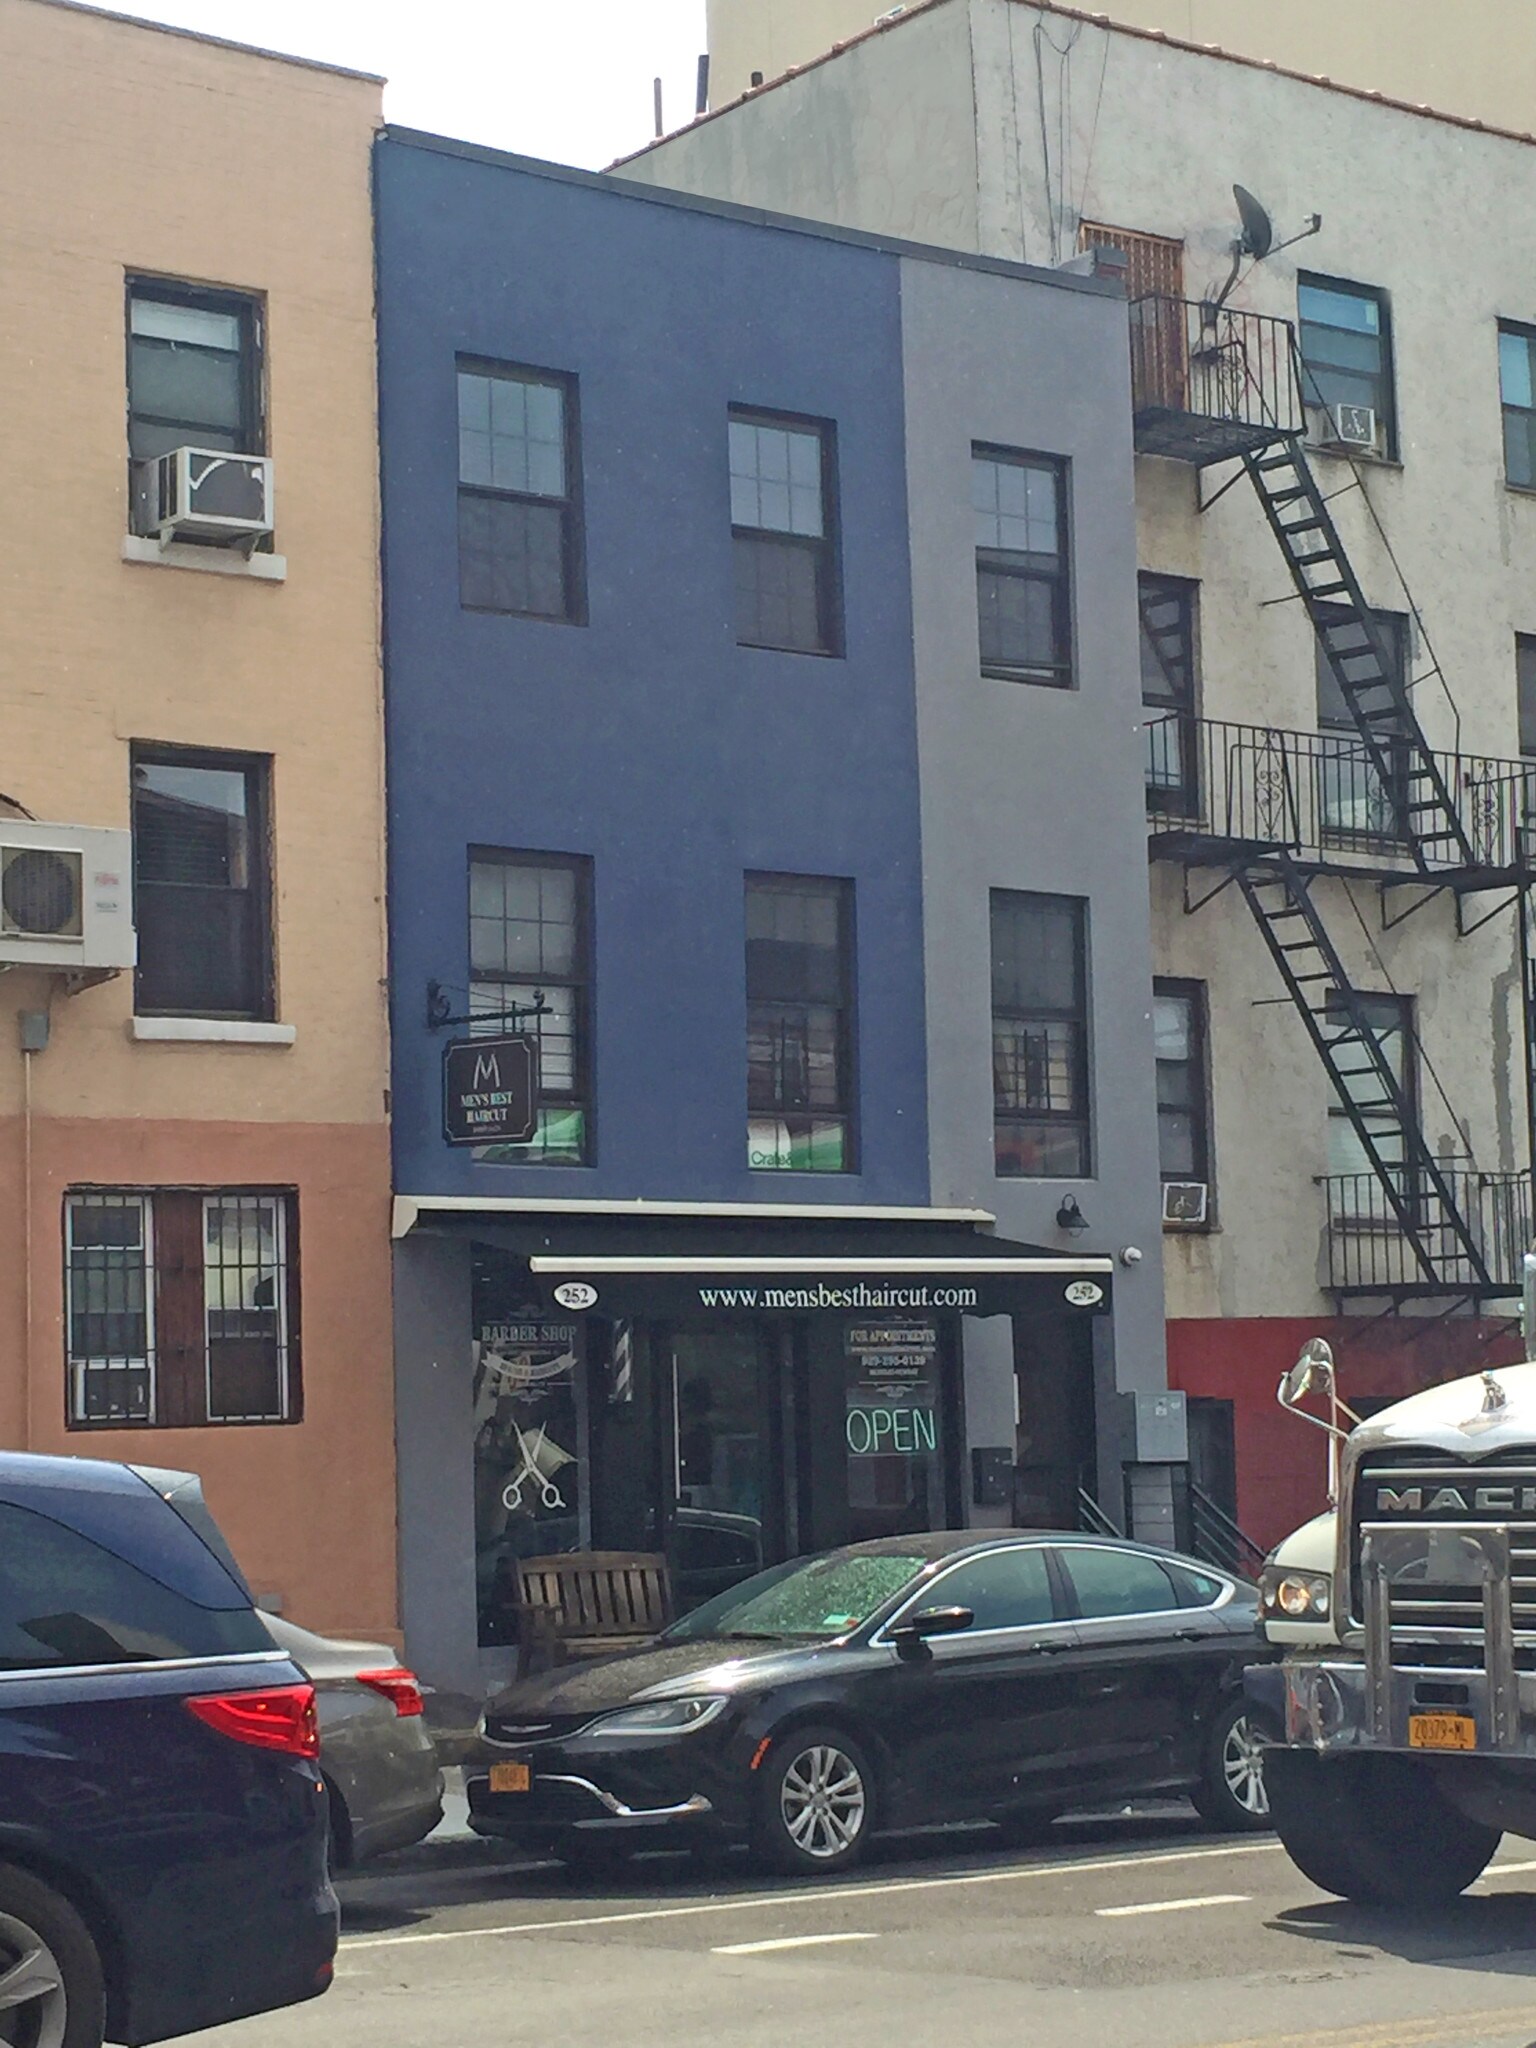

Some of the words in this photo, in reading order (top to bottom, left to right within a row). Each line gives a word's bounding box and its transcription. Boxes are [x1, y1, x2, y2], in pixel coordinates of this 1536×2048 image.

[473, 1053, 500, 1090] M
[466, 1108, 508, 1123] HAIRCUT
[562, 1288, 589, 1304] 252
[699, 1283, 977, 1308] www.mensbesthaircut.com
[1073, 1285, 1095, 1300] 252
[482, 1326, 538, 1341] BARBER
[541, 1326, 577, 1341] SHOP
[870, 1329, 936, 1342] APPOINTMENTS
[846, 1409, 936, 1453] OPEN
